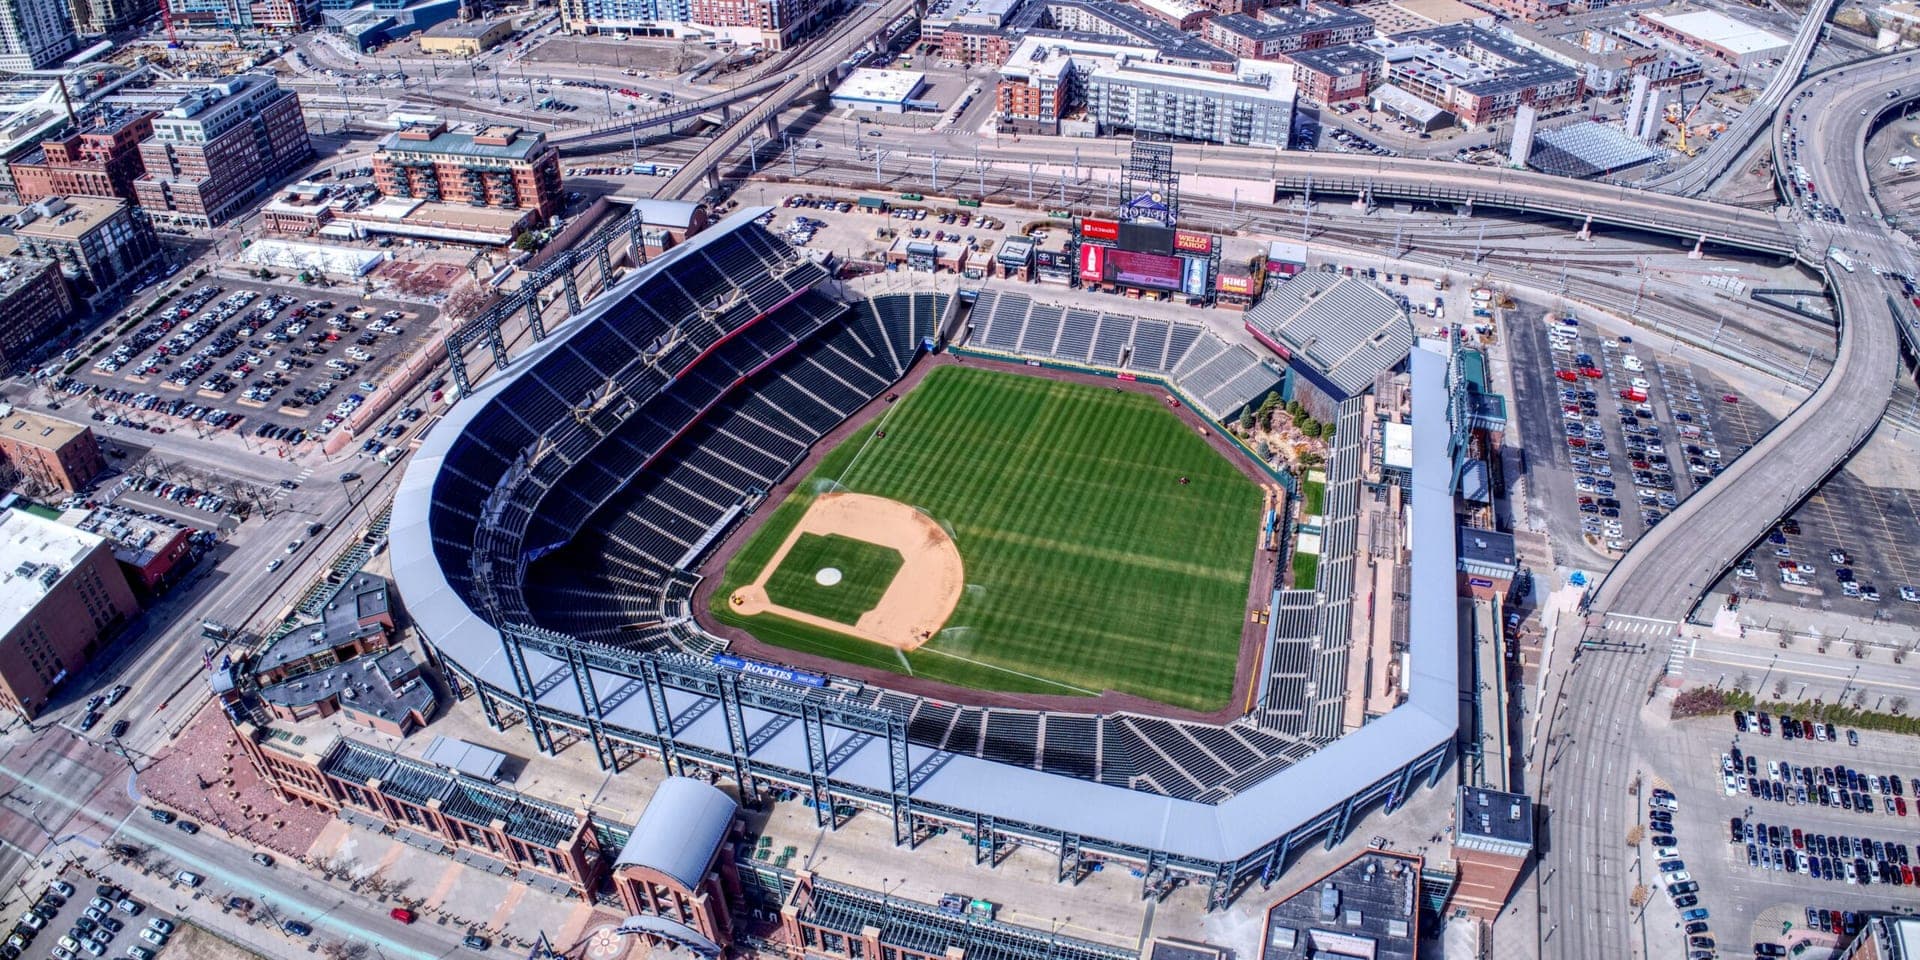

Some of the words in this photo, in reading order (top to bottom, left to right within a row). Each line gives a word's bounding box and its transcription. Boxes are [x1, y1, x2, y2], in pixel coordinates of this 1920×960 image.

[1119, 206, 1177, 226] ROCKIES
[1178, 233, 1208, 245] WELLS
[1178, 240, 1207, 250] FARGO
[742, 662, 793, 681] ROCKIES
